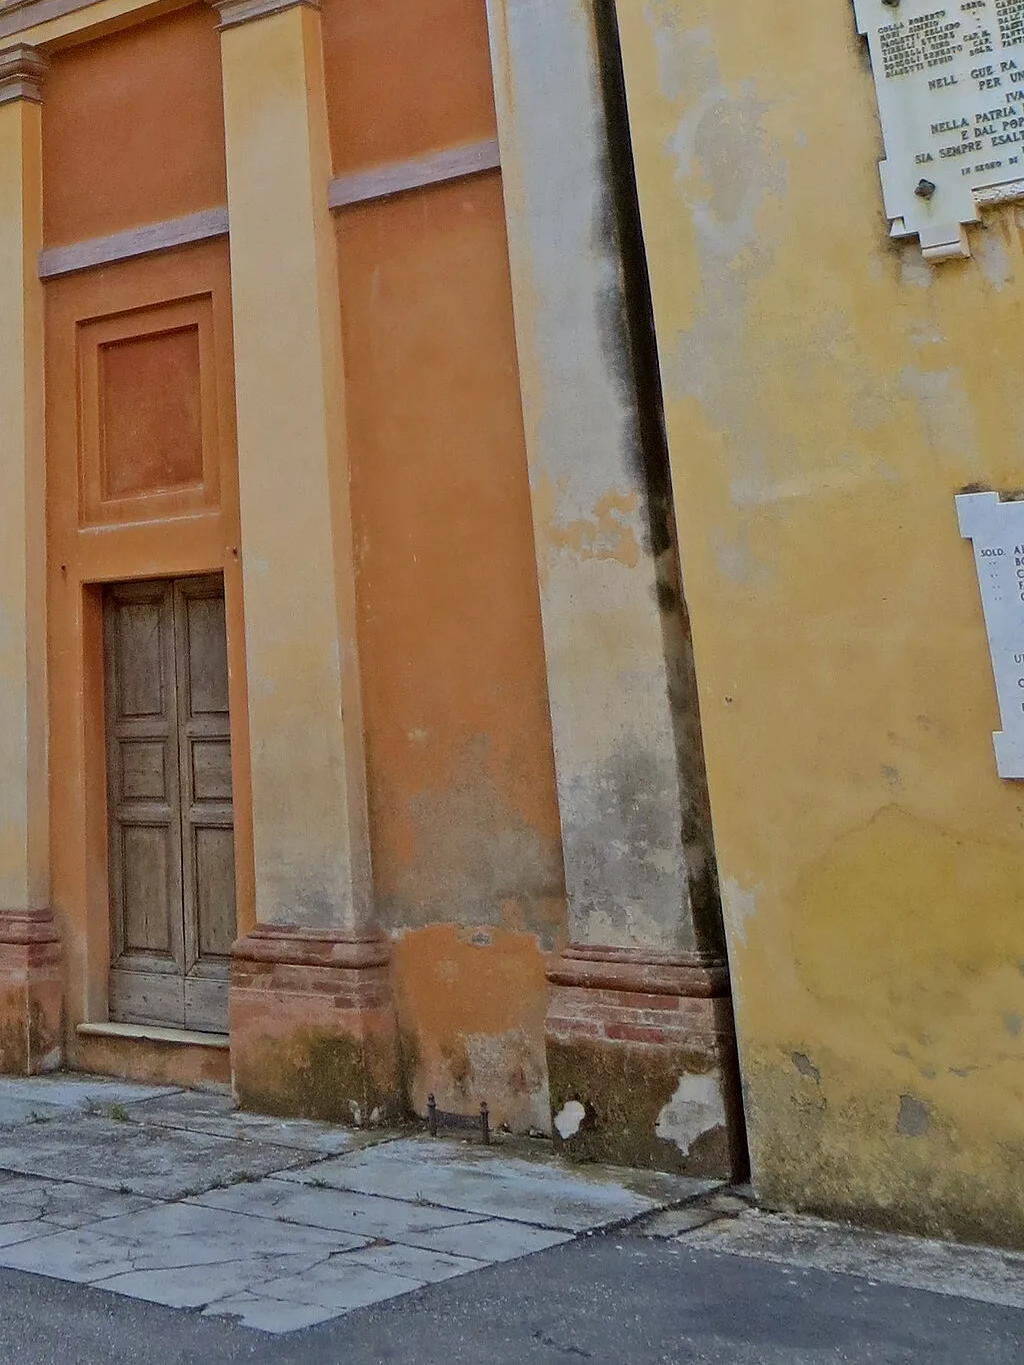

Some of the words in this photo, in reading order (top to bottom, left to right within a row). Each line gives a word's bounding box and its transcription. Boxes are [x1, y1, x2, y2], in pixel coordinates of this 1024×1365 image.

[978, 77, 1002, 90] PER
[930, 117, 970, 134] NELLA
[975, 105, 1017, 124] PATRIA
[961, 130, 969, 141] E
[973, 124, 997, 138] DAL
[914, 152, 934, 165] SIA
[938, 140, 983, 159] SEMPRE
[980, 547, 1006, 557] SOLD.
